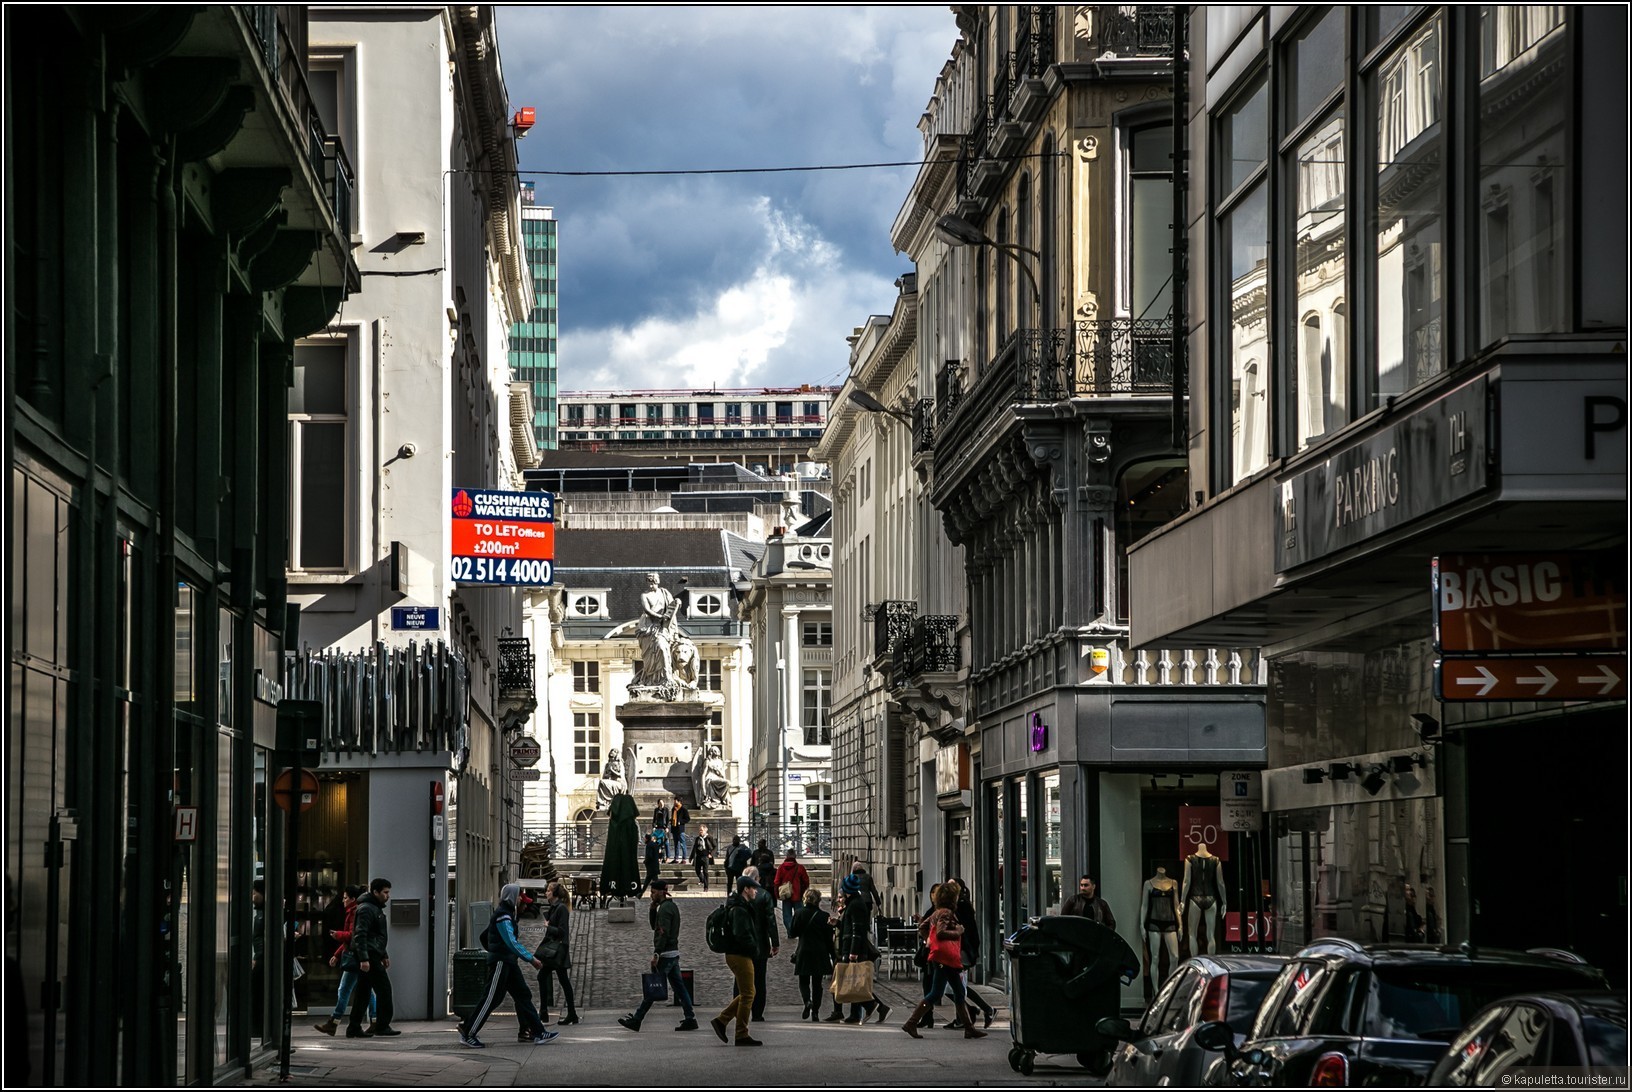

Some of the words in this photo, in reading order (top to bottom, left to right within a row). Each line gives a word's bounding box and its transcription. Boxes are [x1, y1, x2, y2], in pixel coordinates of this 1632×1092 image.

[1336, 447, 1399, 529] PARKING
[474, 494, 540, 507] CUSHMAN
[540, 497, 550, 508] &
[474, 523, 493, 536] TO
[495, 524, 518, 537] LET
[517, 528, 546, 539] Offices
[451, 556, 473, 580] 02
[475, 558, 507, 582] 514
[509, 559, 552, 584] 4000
[646, 756, 681, 764] PATRIA
[1231, 772, 1252, 781] ZONE
[180, 812, 193, 836] H
